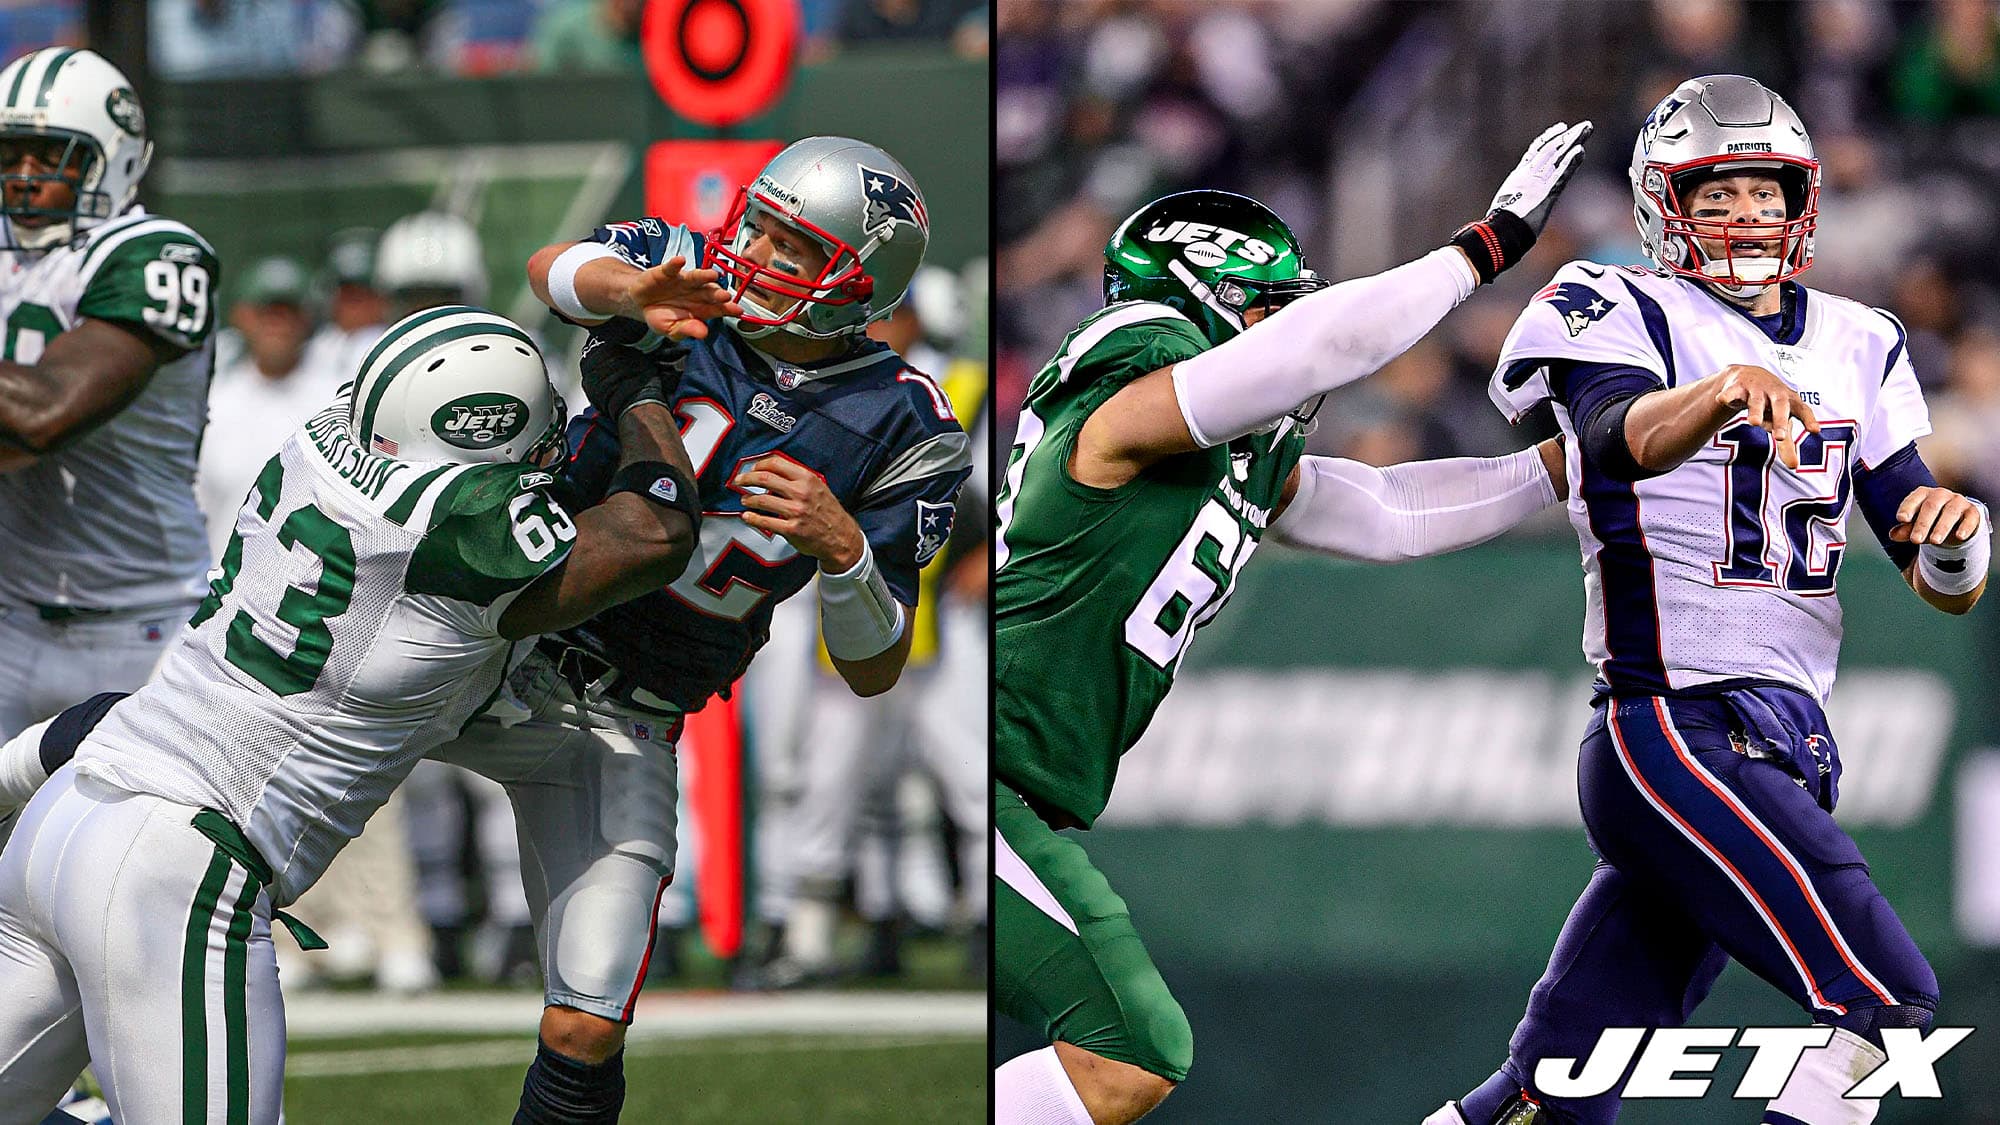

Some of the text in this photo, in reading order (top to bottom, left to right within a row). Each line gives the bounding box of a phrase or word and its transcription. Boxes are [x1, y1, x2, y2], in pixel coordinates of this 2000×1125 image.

[1728, 143, 1772, 153] PATRIOTS
[1147, 220, 1276, 265] JETS
[142, 260, 209, 333] 99
[444, 411, 517, 432] JETS
[509, 492, 578, 563] 63
[664, 396, 828, 623] 12
[1712, 416, 1859, 598] 12
[187, 452, 357, 697] 63
